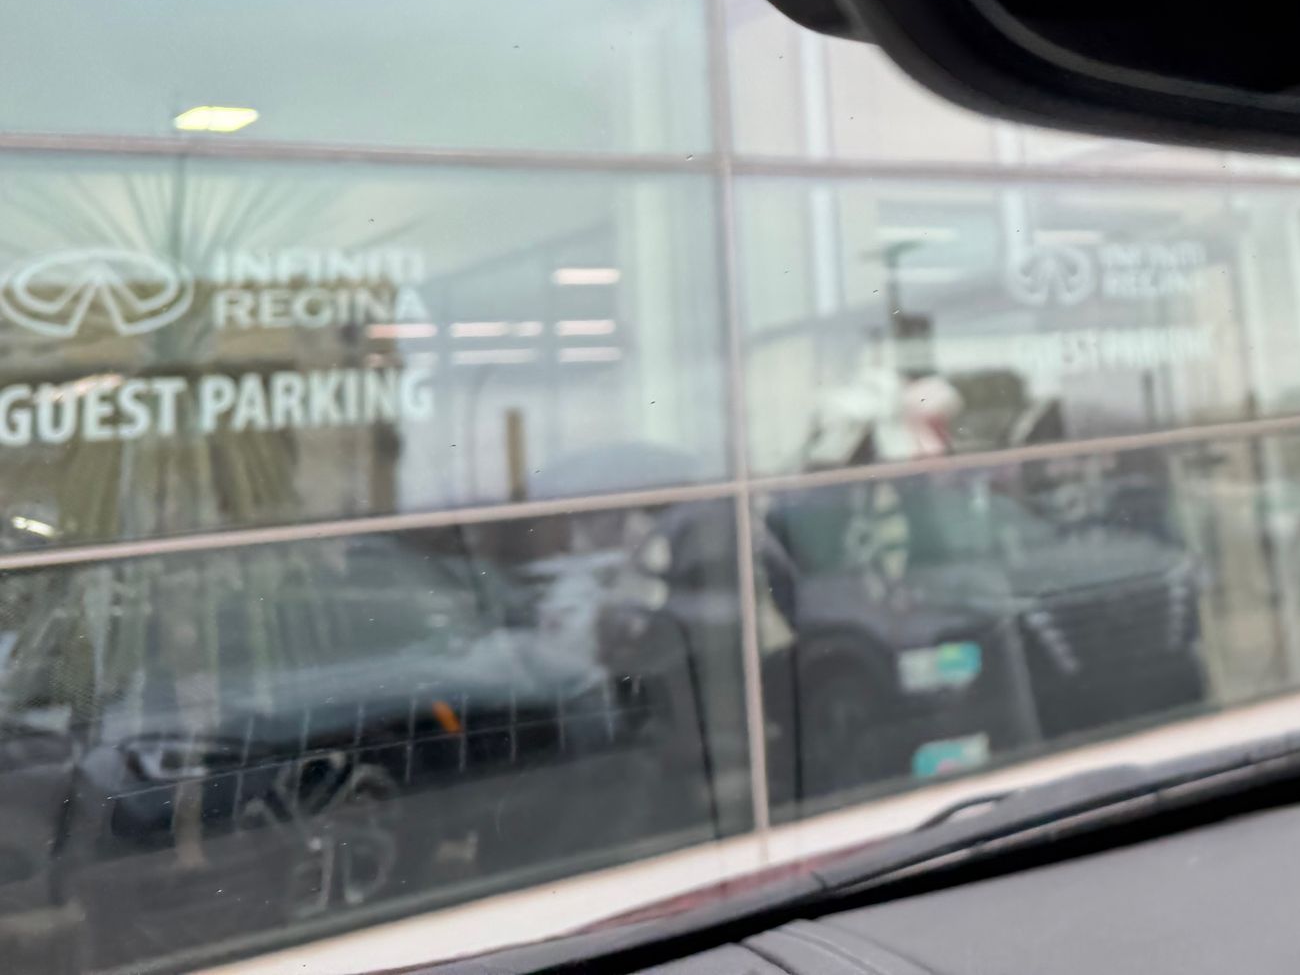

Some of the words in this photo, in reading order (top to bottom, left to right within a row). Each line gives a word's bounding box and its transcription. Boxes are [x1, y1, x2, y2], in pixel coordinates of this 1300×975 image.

[212, 289, 428, 328] REGINA
[0, 378, 186, 446] GUEST
[200, 368, 432, 431] PARKING
